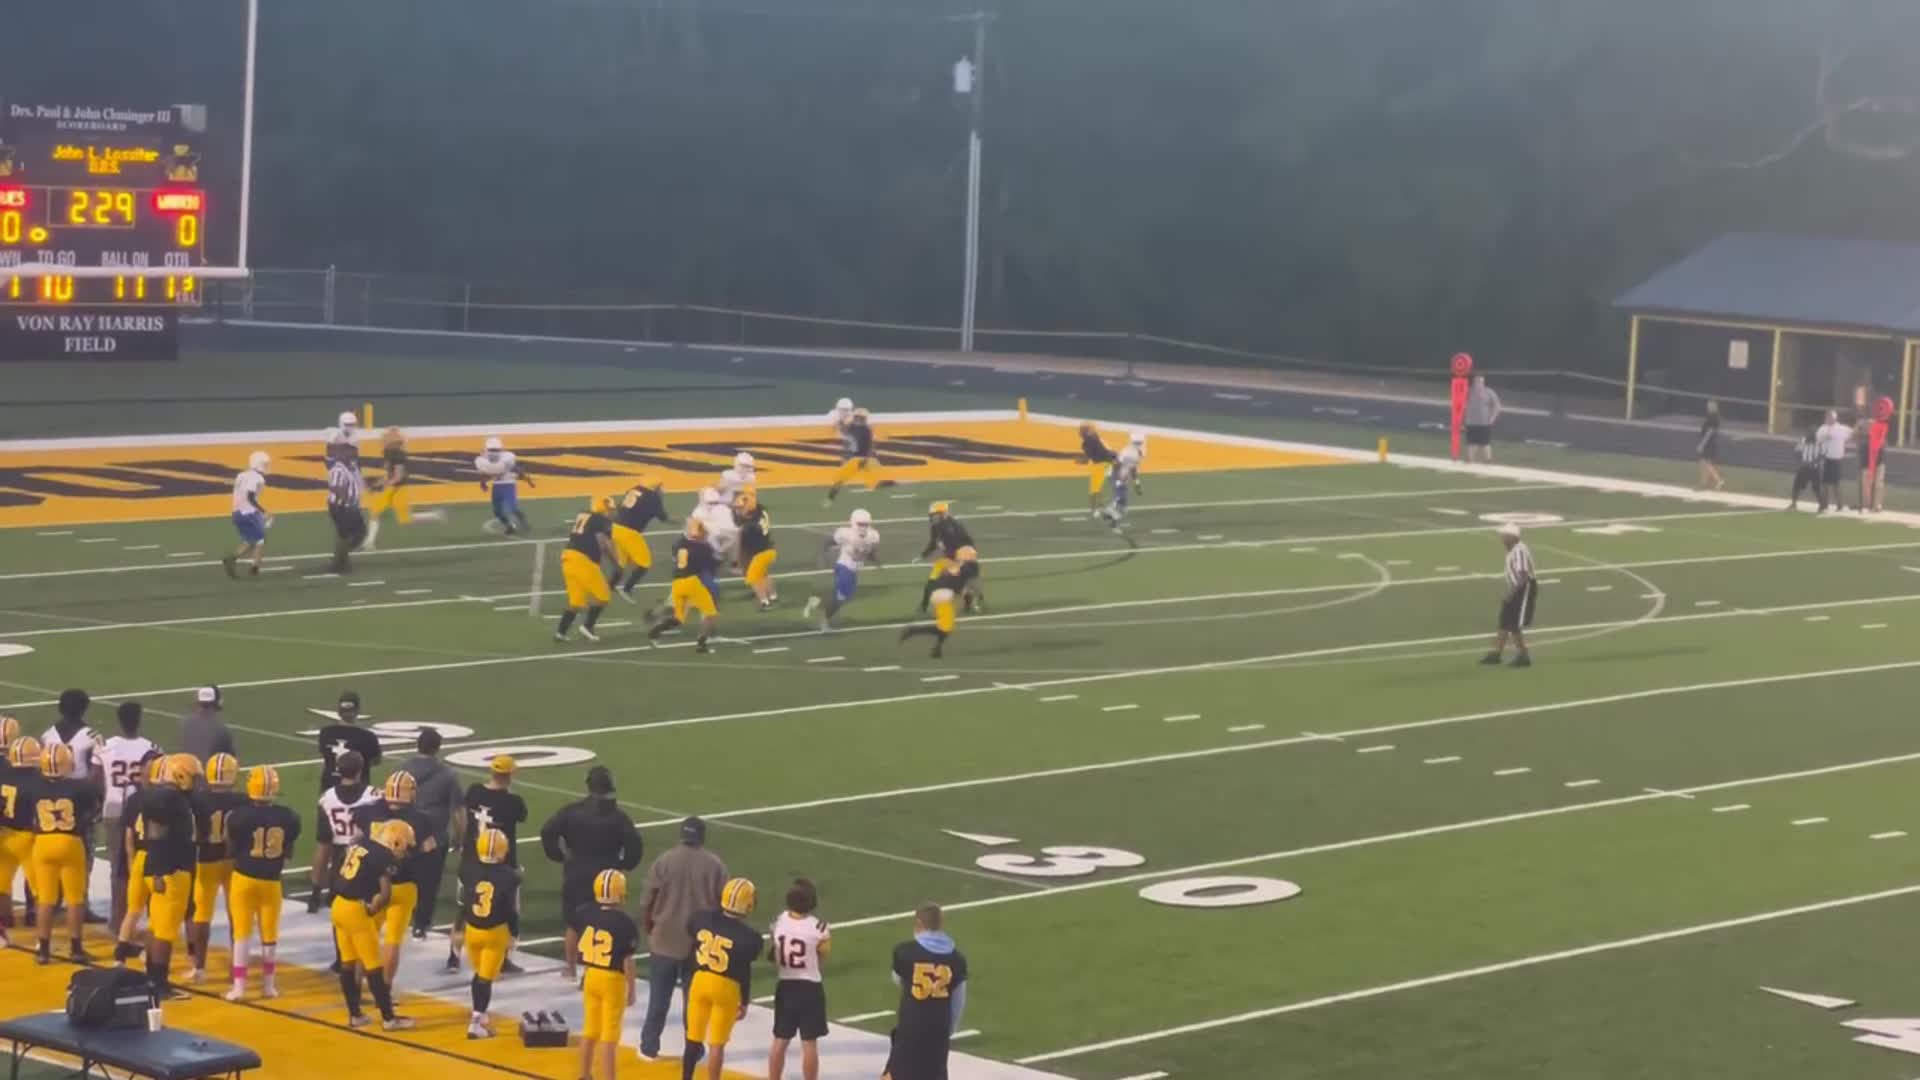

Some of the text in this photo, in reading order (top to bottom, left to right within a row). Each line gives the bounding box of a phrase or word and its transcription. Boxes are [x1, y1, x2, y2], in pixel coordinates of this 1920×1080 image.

[10, 104, 33, 117] Drs.
[36, 105, 60, 118] Paul
[63, 106, 73, 119] &
[74, 107, 101, 120] John
[157, 110, 171, 123] III
[56, 120, 127, 131] SCOREBOARD
[53, 145, 84, 160] John
[178, 214, 197, 246] 0
[37, 251, 76, 267] TO GO
[101, 252, 149, 268] BALL ON
[17, 316, 164, 332] VON RAY HARRIS
[64, 337, 116, 353] FIELD
[111, 760, 143, 788] 22
[36, 798, 76, 832] 63
[472, 880, 495, 918] 3
[577, 925, 613, 967] 42
[695, 929, 734, 973] 35
[778, 935, 807, 969] 12
[911, 962, 952, 1000] 52
